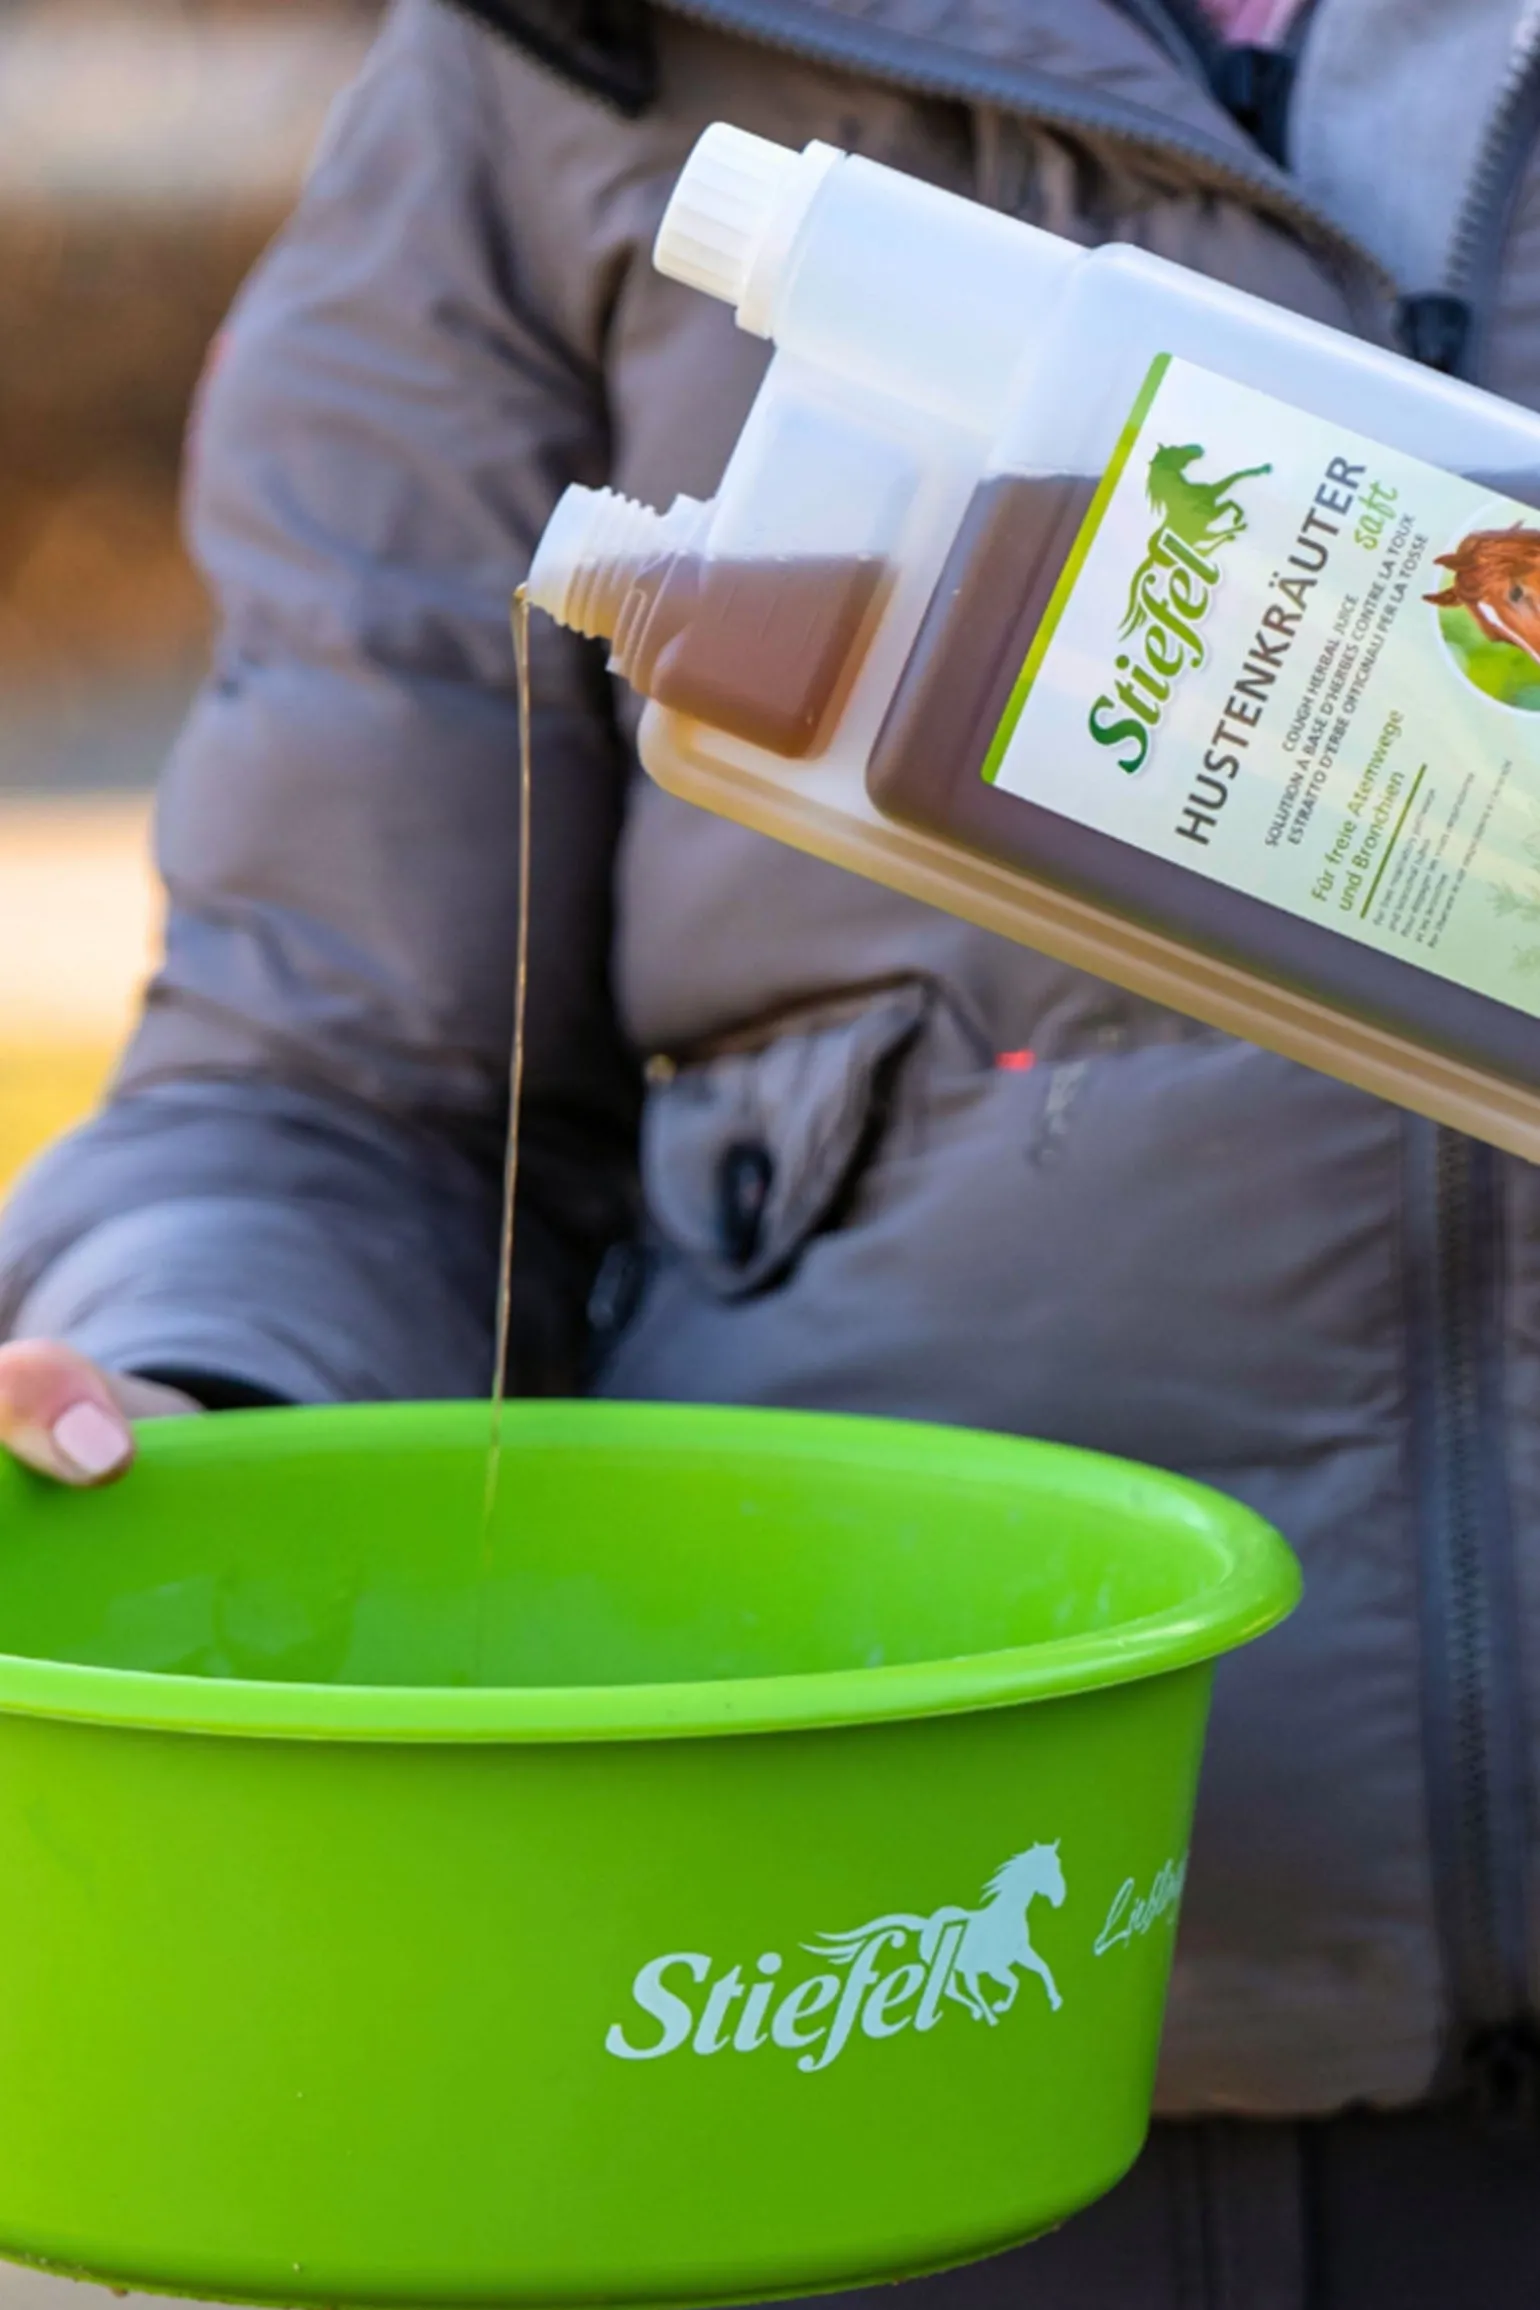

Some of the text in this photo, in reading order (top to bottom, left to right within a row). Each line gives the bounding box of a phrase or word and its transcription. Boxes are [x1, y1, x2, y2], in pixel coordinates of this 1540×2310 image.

[1353, 481, 1398, 551] saft
[1386, 515, 1413, 556] TOUX
[1378, 560, 1396, 580] LA
[1398, 534, 1428, 579] TOSSE
[1351, 581, 1385, 642] CONTRE
[1376, 604, 1397, 634] PER
[1389, 582, 1408, 603] LA
[1088, 534, 1220, 775] Stiefel
[1174, 456, 1366, 846] HUSTENKRÄUTER
[1282, 594, 1359, 752] COUGH HERBAL JUICE
[1319, 644, 1359, 717] D'HERBES
[1302, 717, 1328, 756] BASE
[1264, 772, 1304, 847] SOLUTION
[1287, 770, 1327, 845] ESTRATTO
[1310, 710, 1402, 902] Für freie Atemwege
[1350, 771, 1405, 870] Bronchien
[1339, 870, 1363, 912] und
[605, 1924, 966, 2073] Stiefel
